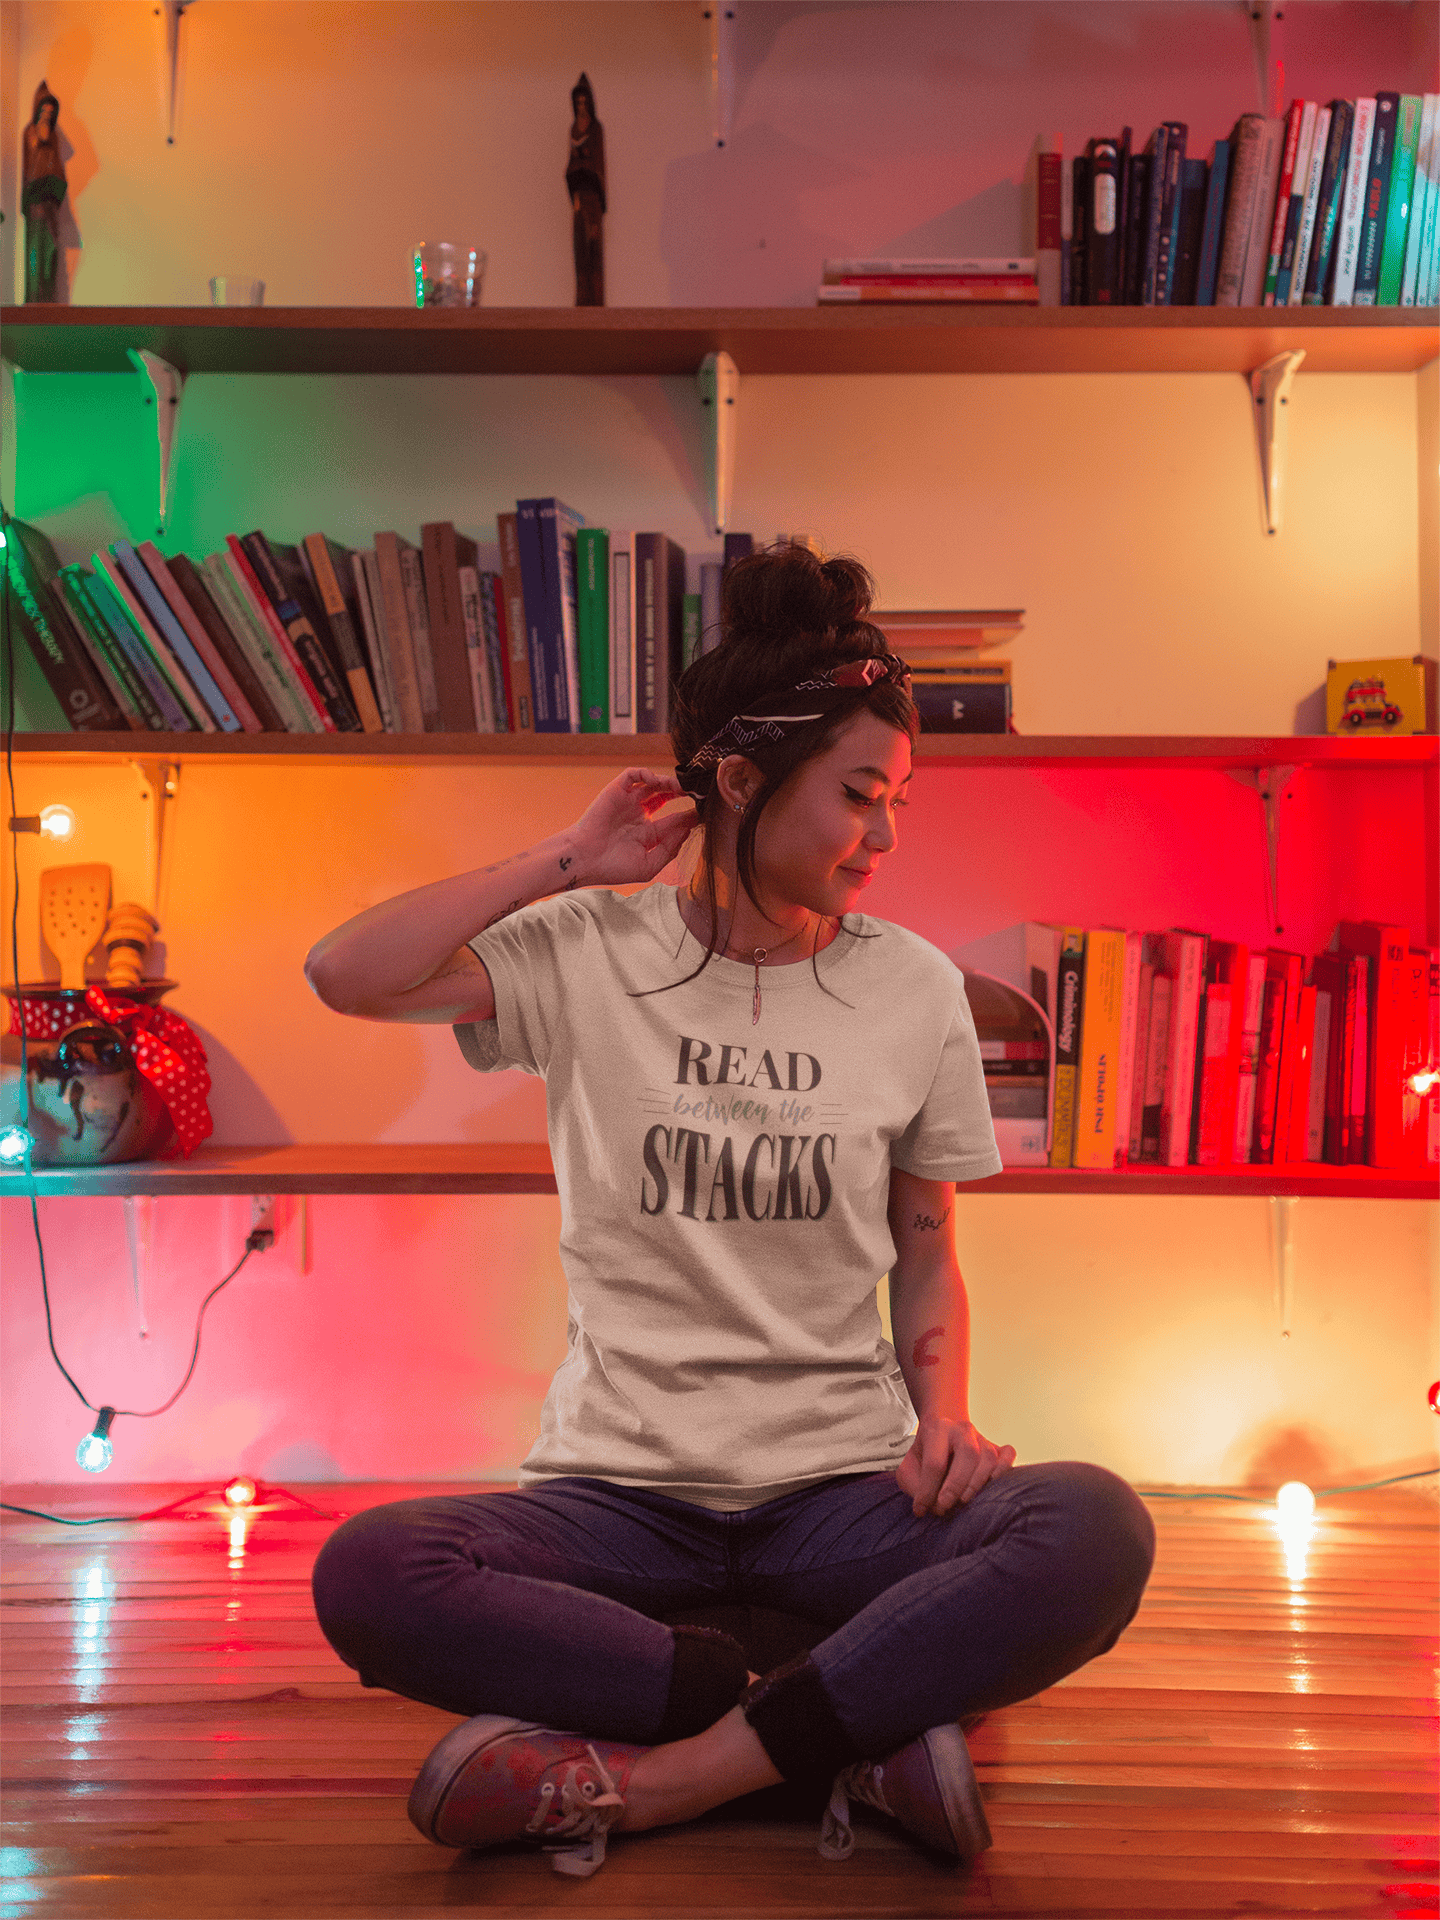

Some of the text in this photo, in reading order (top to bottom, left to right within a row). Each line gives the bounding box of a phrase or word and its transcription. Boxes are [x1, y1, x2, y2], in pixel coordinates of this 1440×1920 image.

[1058, 970, 1079, 1052] Criminology
[673, 1034, 822, 1092] READ
[673, 1093, 815, 1126] between the
[640, 1123, 837, 1222] STACKS
